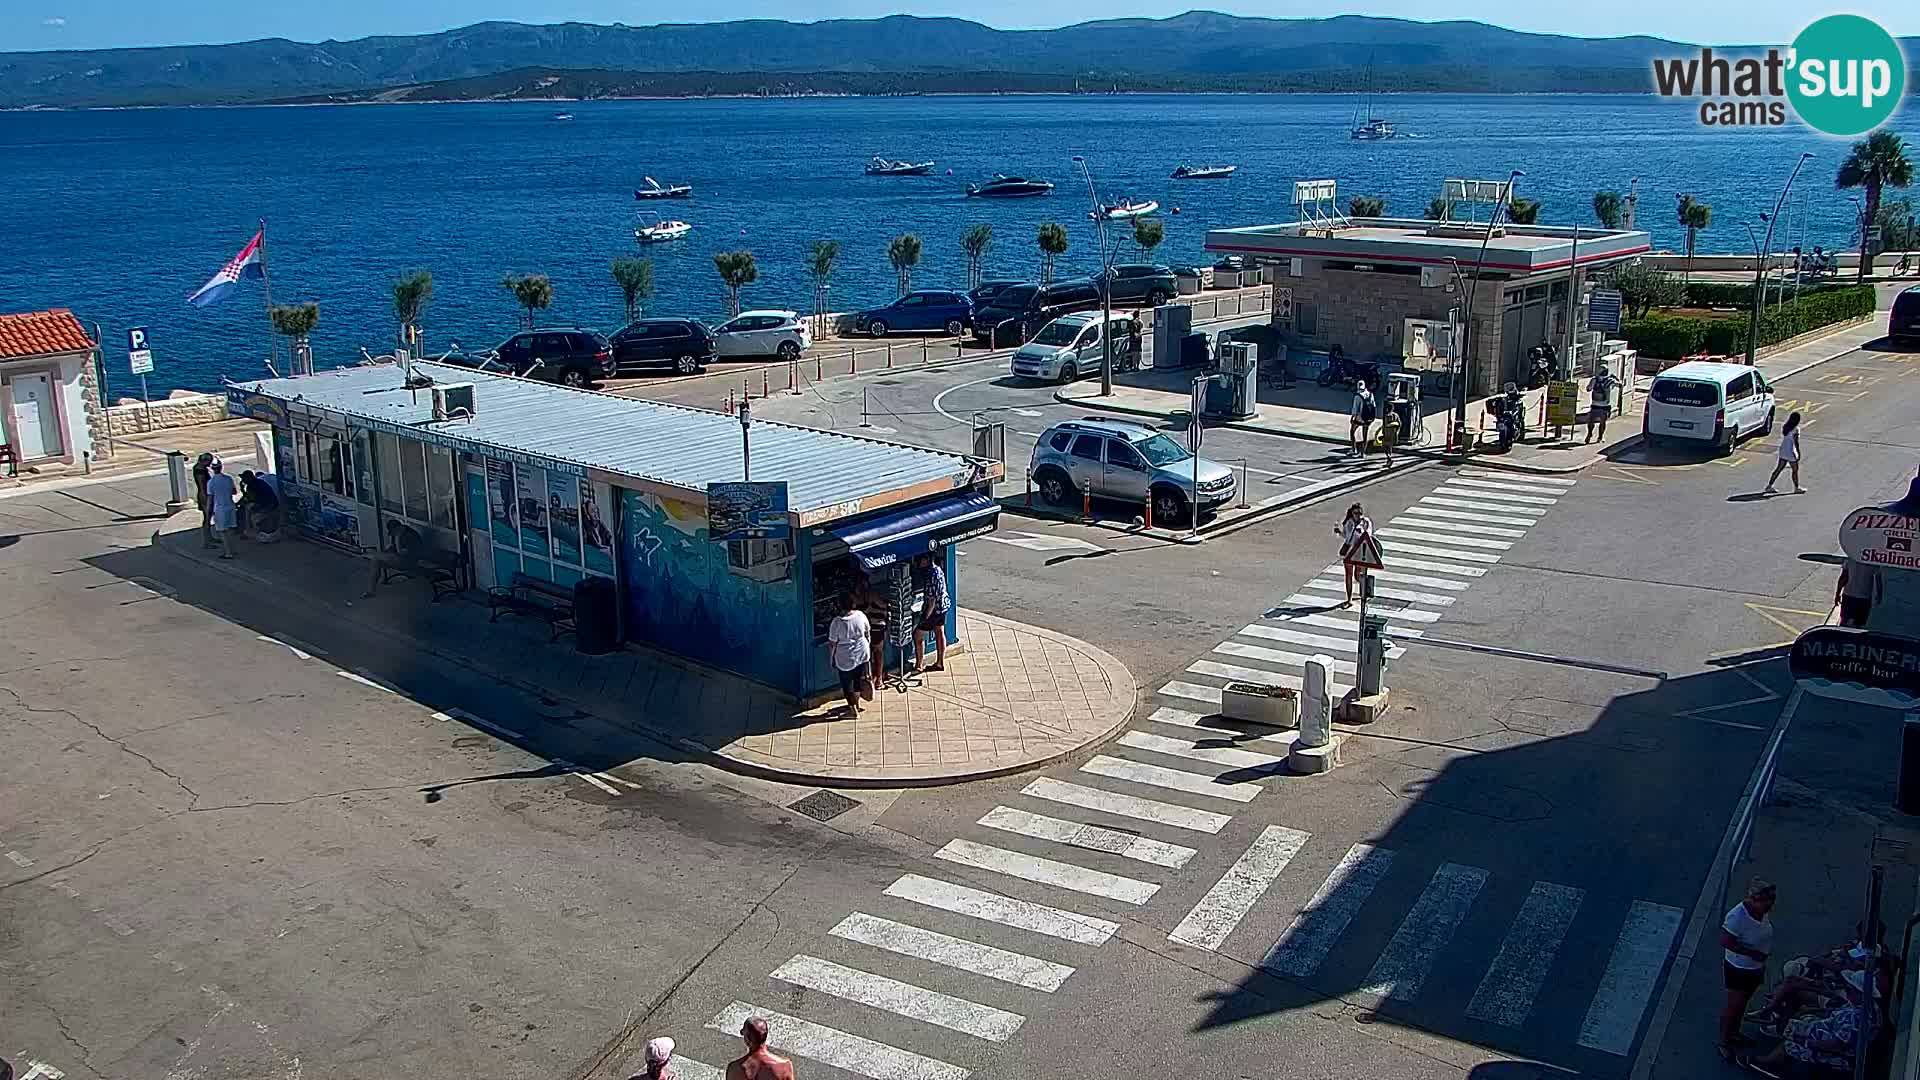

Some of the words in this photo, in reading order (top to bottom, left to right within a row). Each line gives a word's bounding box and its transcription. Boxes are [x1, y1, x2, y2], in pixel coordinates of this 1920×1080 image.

[132, 330, 144, 348] P
[480, 446, 494, 456] BUS
[496, 449, 527, 464] STATION
[531, 456, 554, 470] TICKET
[557, 461, 583, 476] OFFICE
[1849, 514, 1920, 533] PIZZE
[864, 553, 897, 568] Novine
[1802, 640, 1920, 673] MARINER
[1872, 664, 1899, 679] bar
